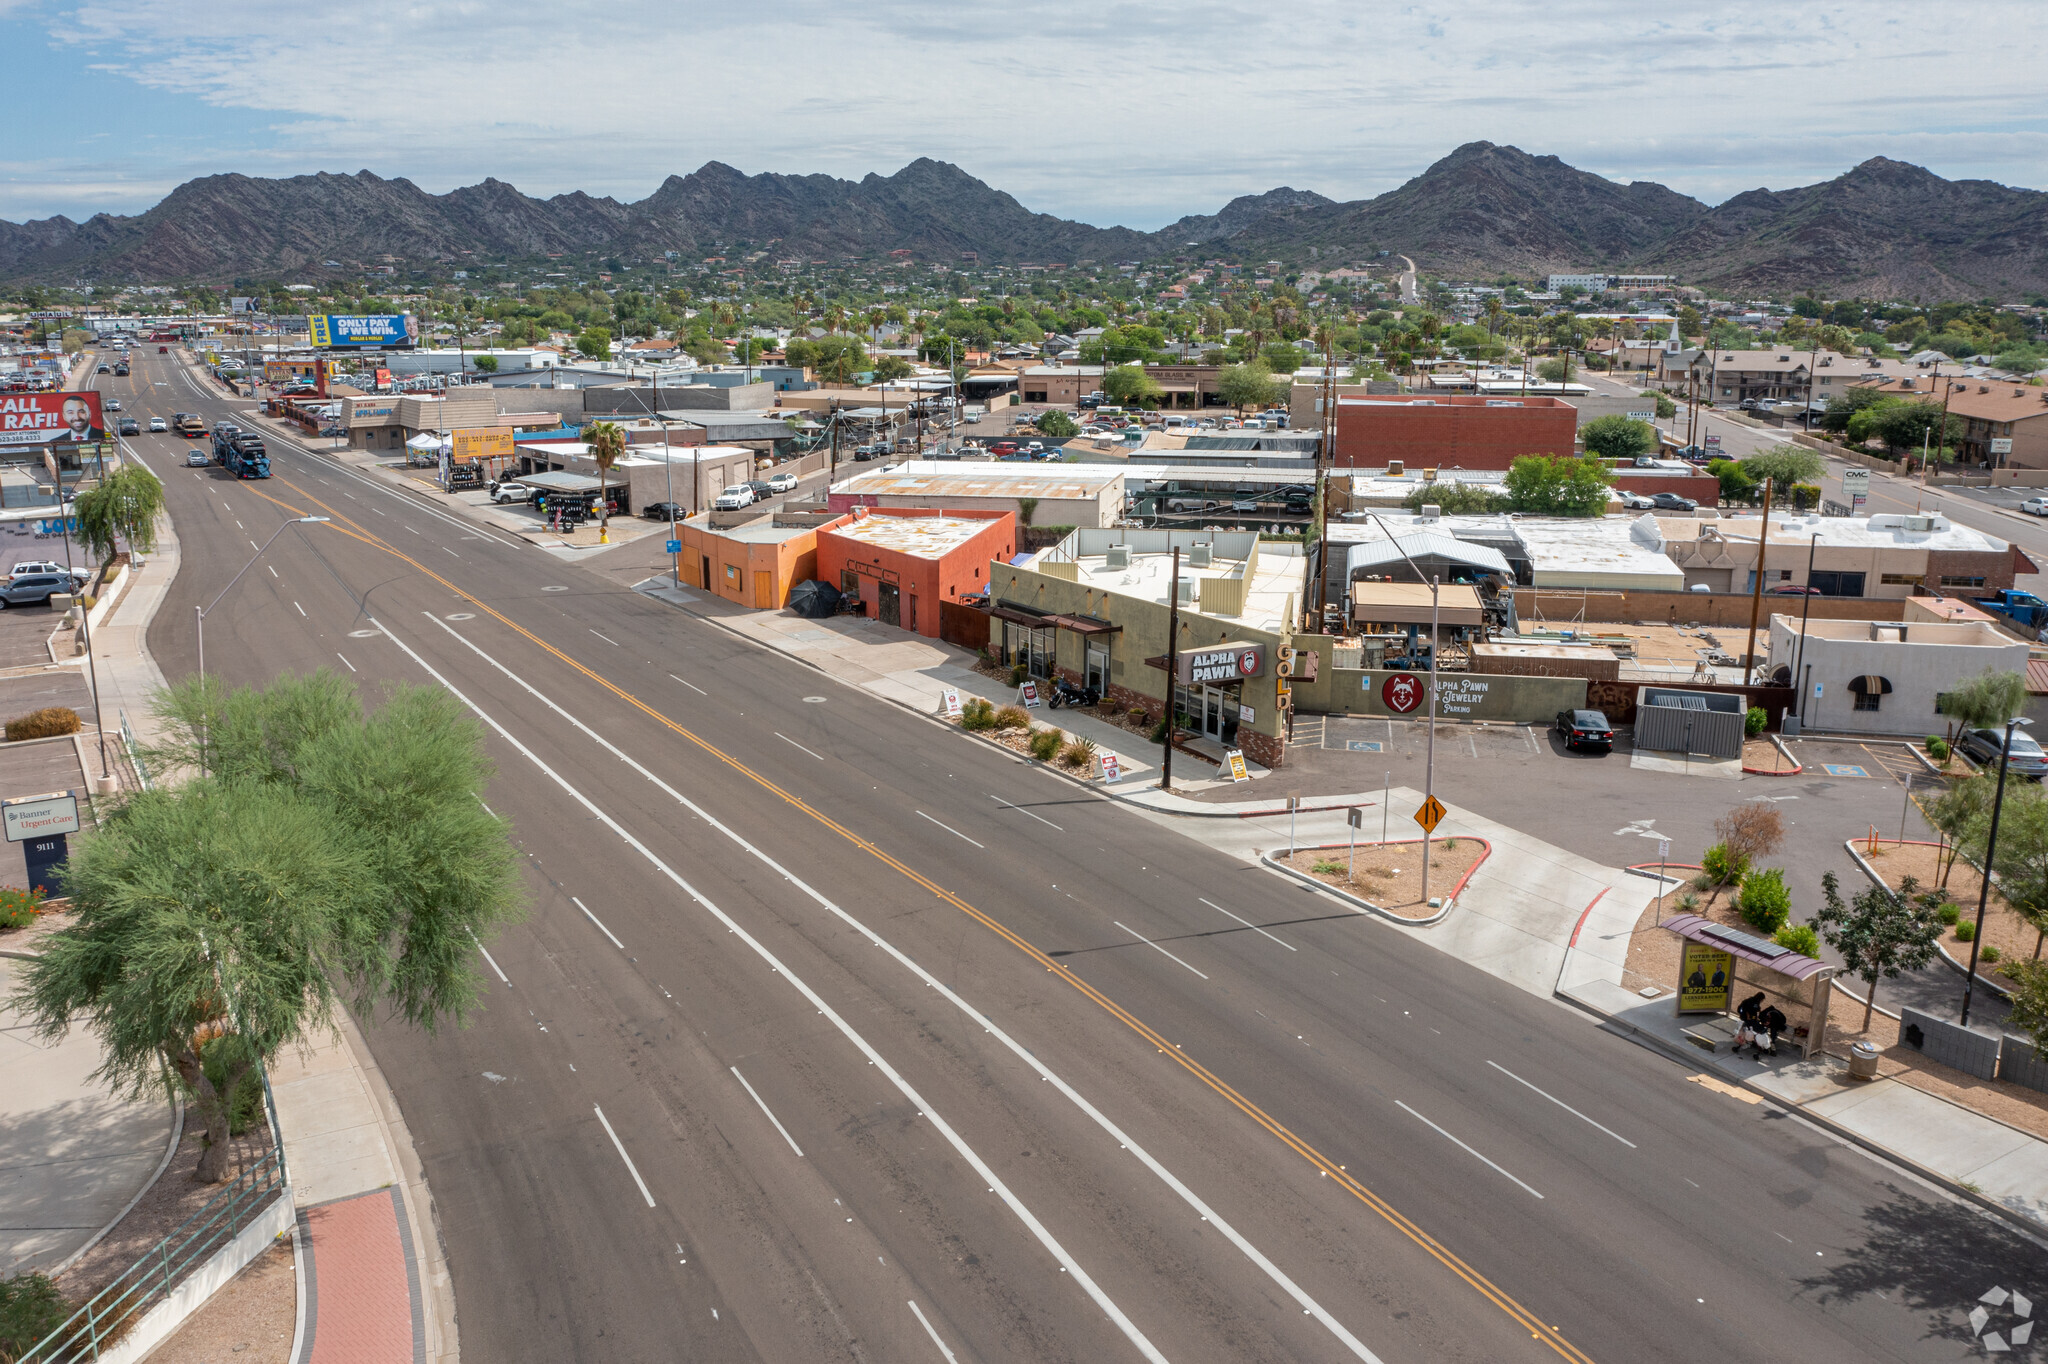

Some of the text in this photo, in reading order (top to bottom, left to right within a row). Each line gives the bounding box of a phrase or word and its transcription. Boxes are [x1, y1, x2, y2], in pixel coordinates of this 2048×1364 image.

[313, 316, 328, 343] FREE
[338, 319, 390, 328] ONLY PAY
[350, 327, 368, 335] WE
[370, 326, 398, 335] WIN.
[4, 412, 58, 430] RAFI!
[1193, 652, 1235, 667] ALPHA
[1192, 664, 1236, 682] PAWN
[1276, 644, 1292, 710] GOLD
[1460, 680, 1488, 692] PAWN
[1442, 690, 1484, 704] JEWELRY
[20, 808, 51, 820] Banner
[20, 816, 73, 829] Urgent Care
[36, 842, 54, 852] 9111
